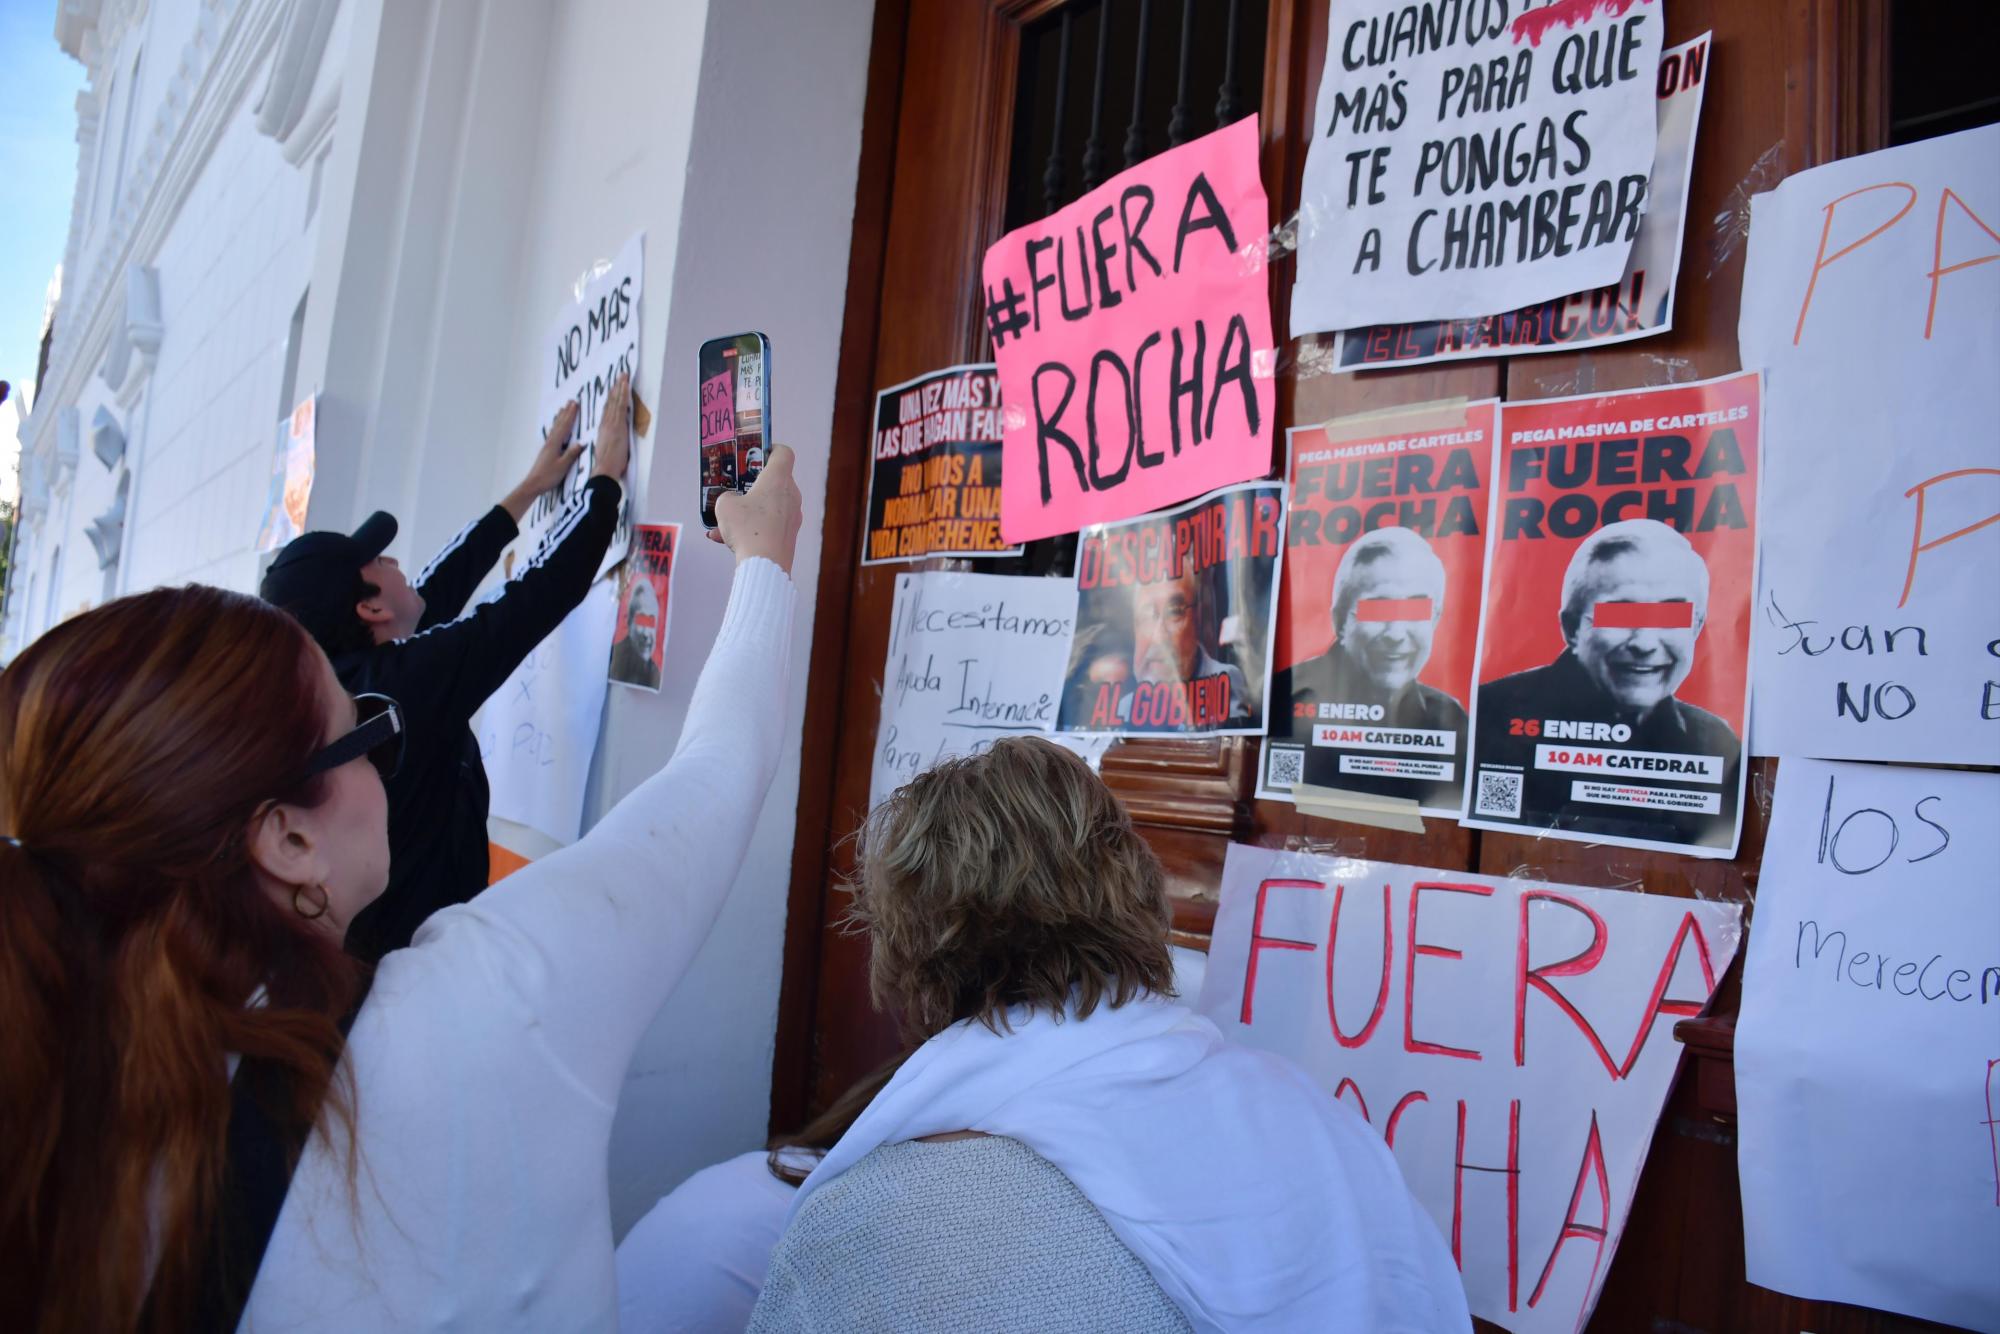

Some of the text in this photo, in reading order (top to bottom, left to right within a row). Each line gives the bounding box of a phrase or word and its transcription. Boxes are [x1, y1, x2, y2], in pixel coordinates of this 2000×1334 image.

[1342, 0, 1509, 71] CUANTOS
[1438, 49, 1533, 121] PARA
[1553, 15, 1647, 94] QUE
[1345, 110, 1591, 208] TE PONGAS
[1352, 175, 1648, 276] A CHAMBEAR
[987, 172, 1239, 349] #FUERA
[556, 325, 582, 388] NO
[942, 372, 985, 410] MÁS
[1032, 314, 1260, 508] ROCHA
[876, 428, 901, 460] LAS
[901, 421, 923, 455] QUE
[1299, 430, 1483, 464] PEGA MASIVA DE CARTELES
[1511, 406, 1748, 445] PEGA MASIVA DE CARTELES
[967, 454, 983, 486] A
[1293, 448, 1480, 503] FUERA
[1508, 428, 1746, 492] FUERA
[960, 486, 1001, 519] UNA
[1288, 495, 1480, 546] ROCHA
[1502, 483, 1748, 541] ROCHA
[1079, 496, 1281, 590] DESCAPTURAR
[1090, 681, 1123, 727] AL
[1319, 703, 1385, 721] ENERO
[1837, 681, 1916, 723] NO
[1321, 729, 1444, 748] 10 AM CATEDRAL
[1509, 719, 1631, 743] 26 ENERO
[1547, 751, 1708, 775] 10 AM CATEDRAL
[1680, 793, 1708, 801] PUEBLO
[1240, 878, 1717, 1081] FUERA
